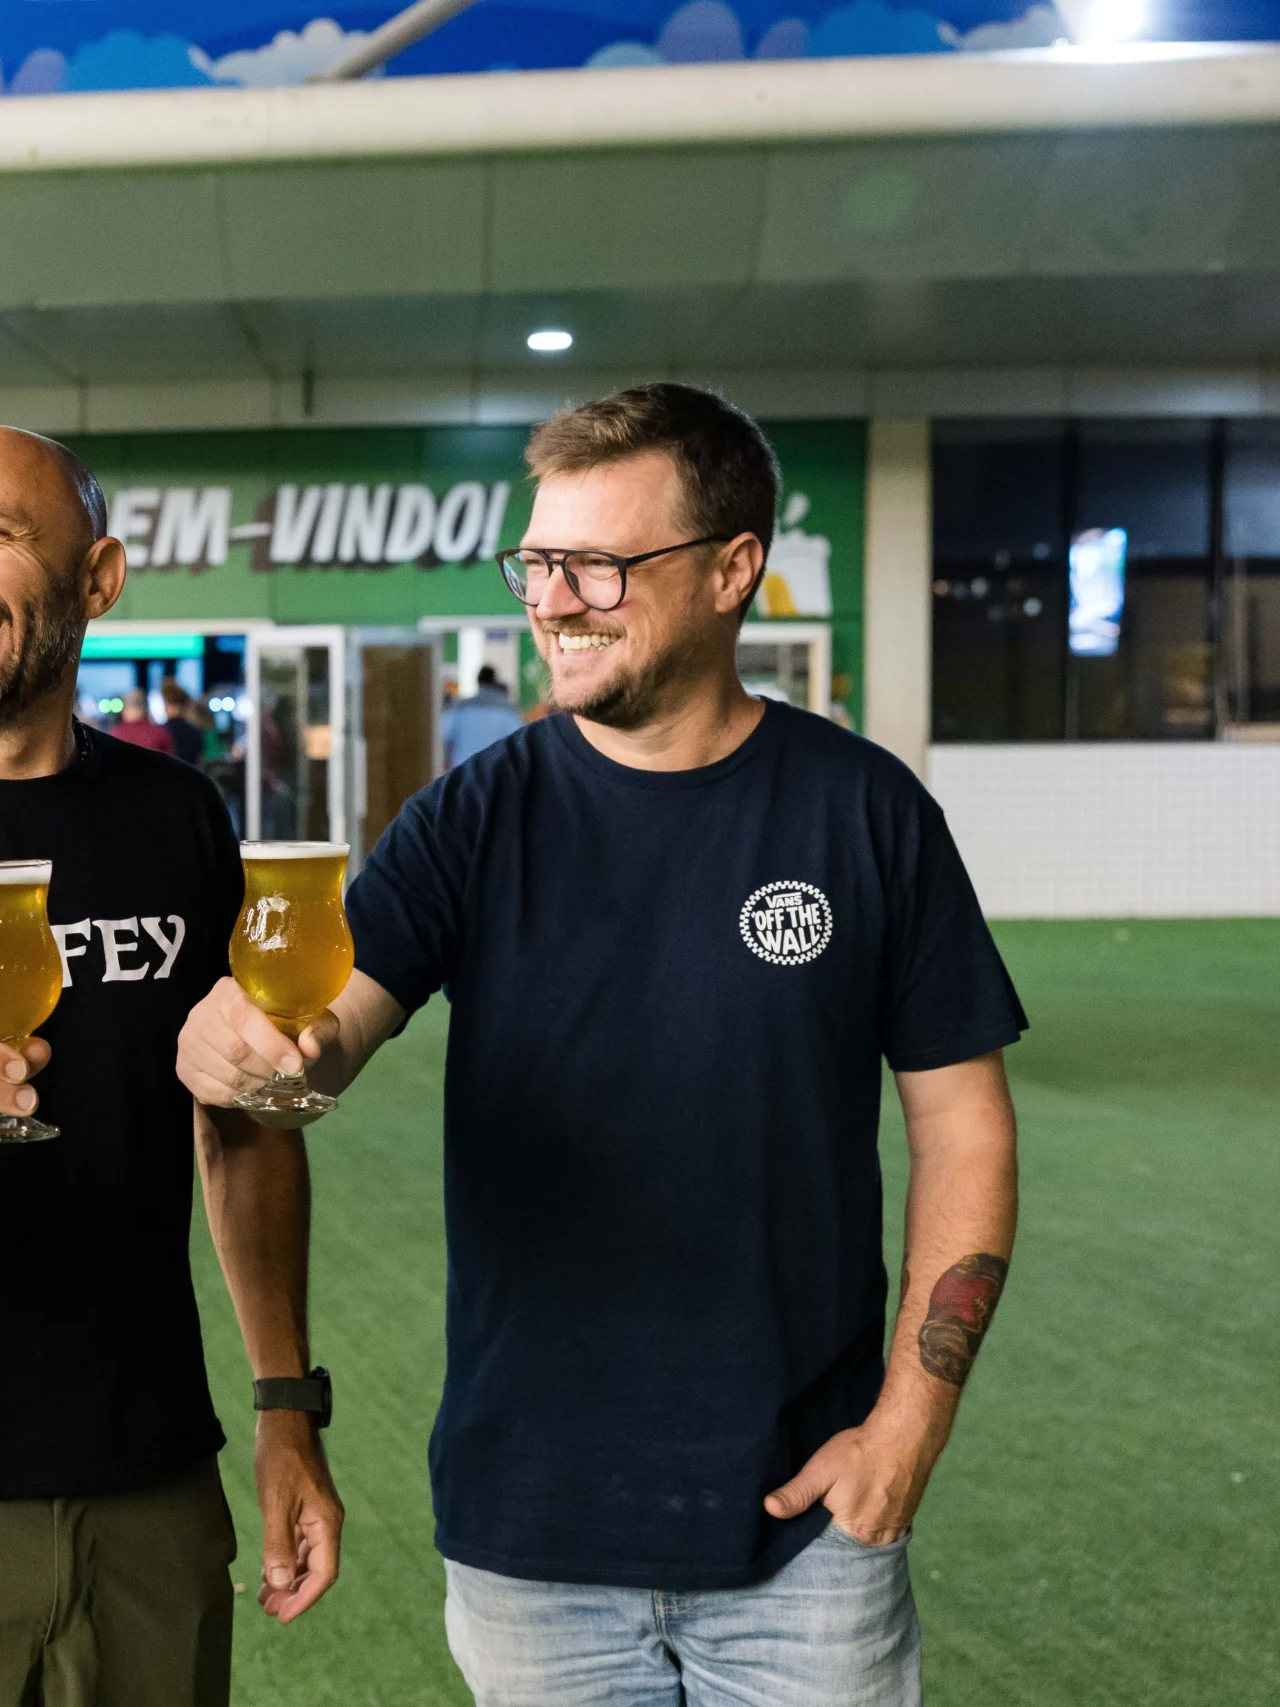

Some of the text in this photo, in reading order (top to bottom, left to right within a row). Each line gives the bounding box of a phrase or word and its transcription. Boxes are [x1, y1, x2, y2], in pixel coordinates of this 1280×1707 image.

[108, 480, 510, 567] EM-VINDO!
[764, 891, 803, 909] VANS
[786, 903, 821, 928] THE
